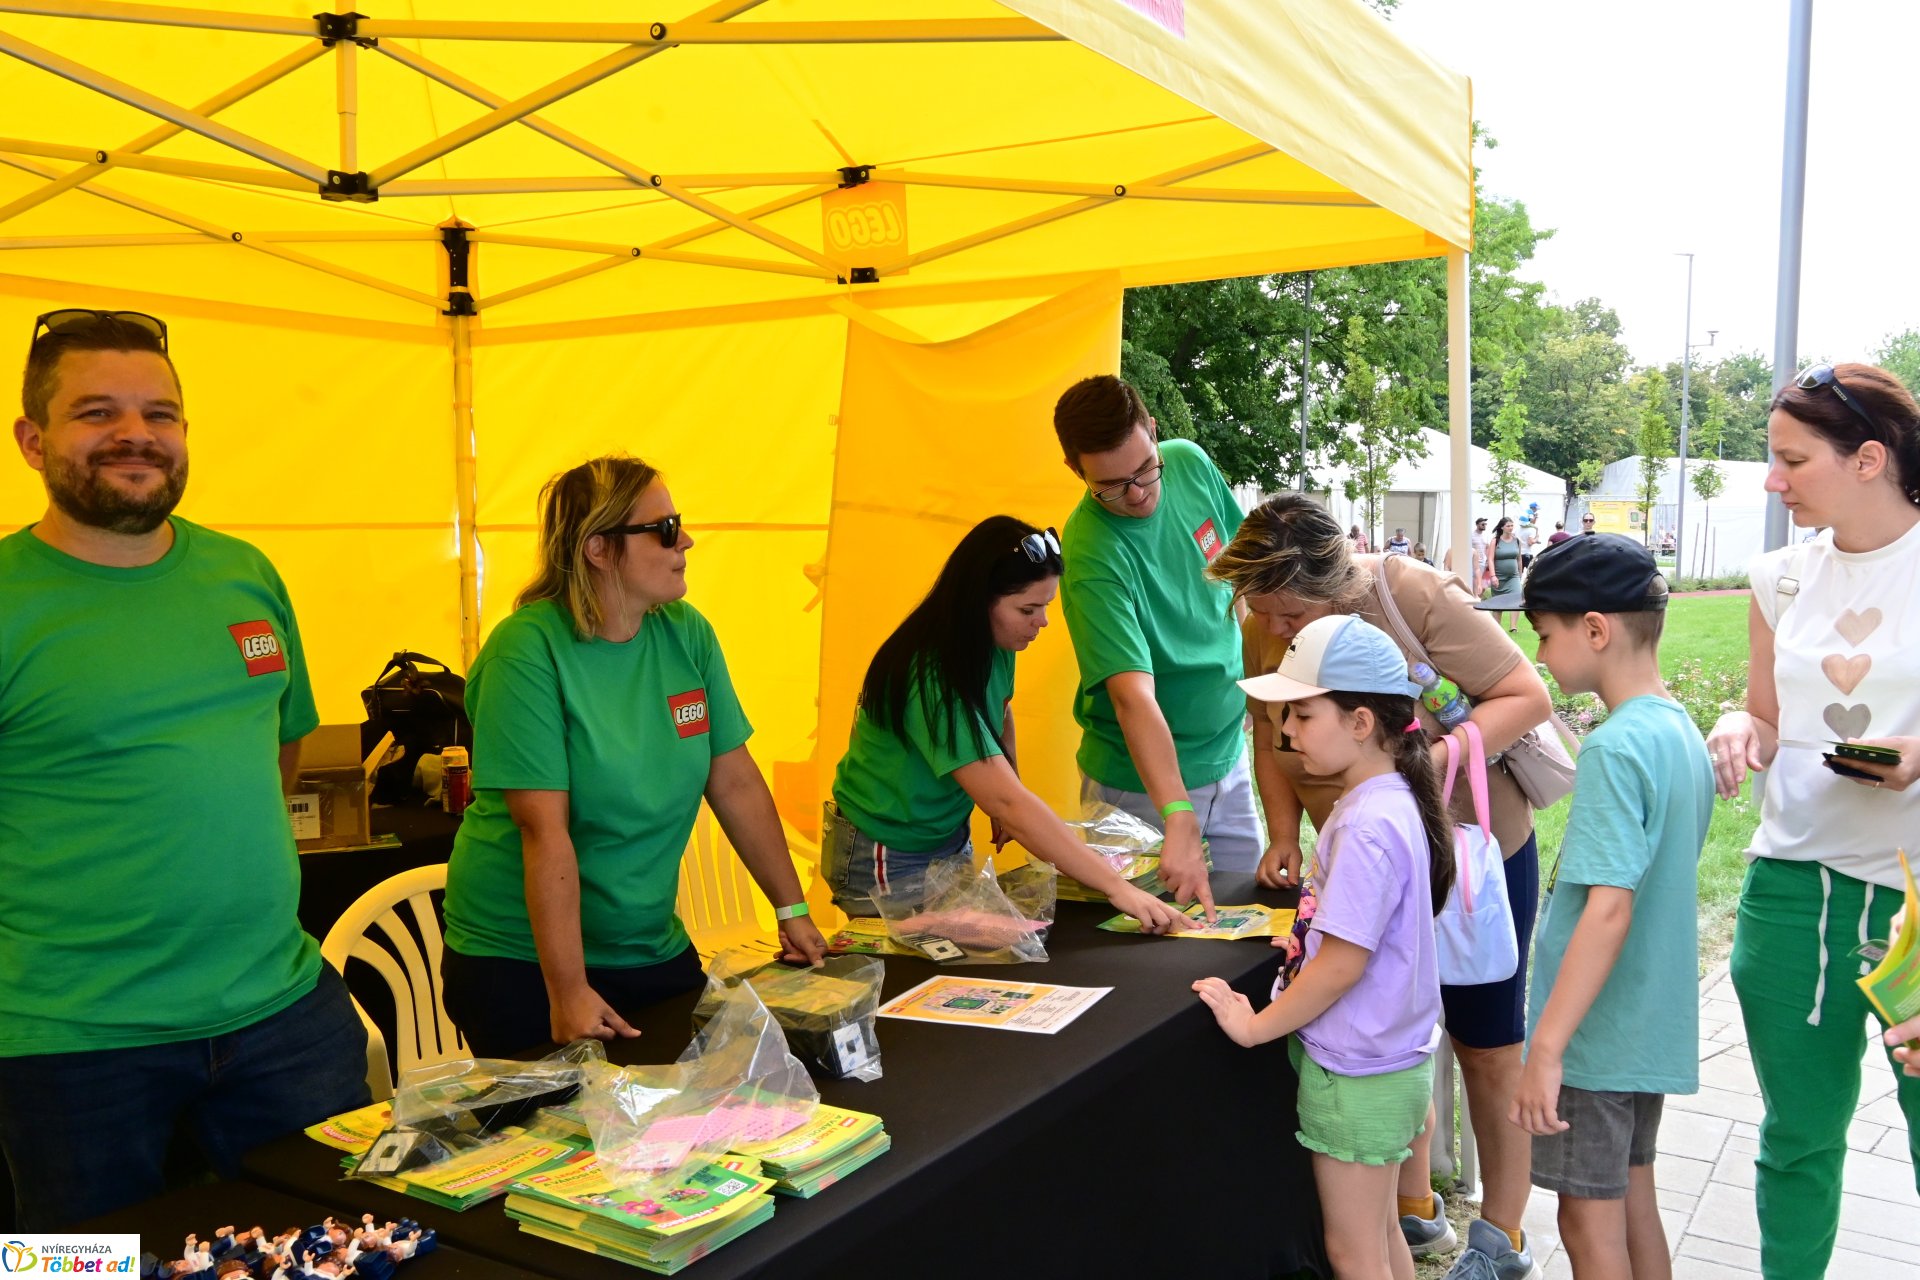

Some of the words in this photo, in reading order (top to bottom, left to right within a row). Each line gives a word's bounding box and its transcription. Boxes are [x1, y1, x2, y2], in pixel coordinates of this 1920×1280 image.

[1200, 528, 1216, 552] LEGO
[243, 634, 279, 659] LEGO
[675, 702, 705, 725] LEGO
